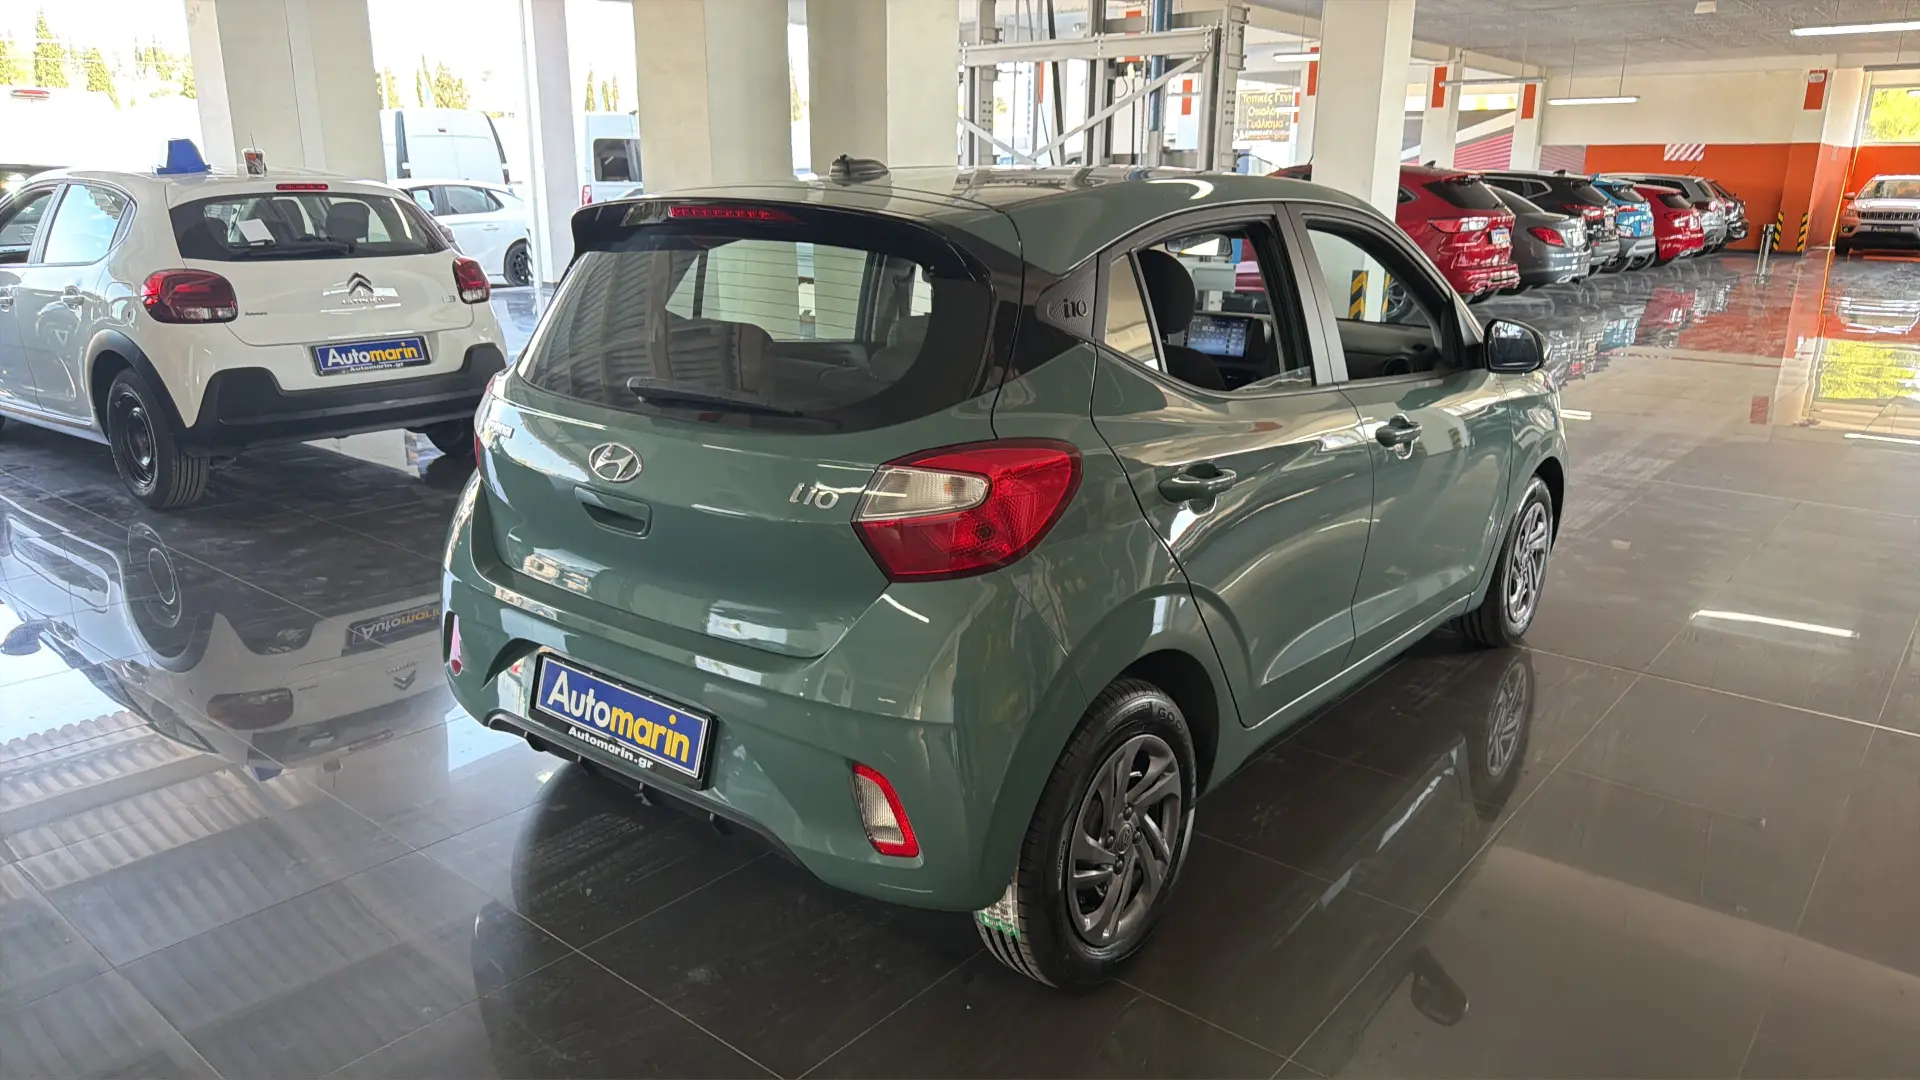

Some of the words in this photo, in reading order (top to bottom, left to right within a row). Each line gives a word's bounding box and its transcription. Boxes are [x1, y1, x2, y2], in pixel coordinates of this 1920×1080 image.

[1063, 298, 1088, 318] i10
[327, 341, 419, 367] Automarin
[349, 362, 405, 372] Automarin.gr
[789, 482, 839, 509] i10
[547, 670, 690, 763] Automarin
[568, 726, 654, 769] Automarin.gr
